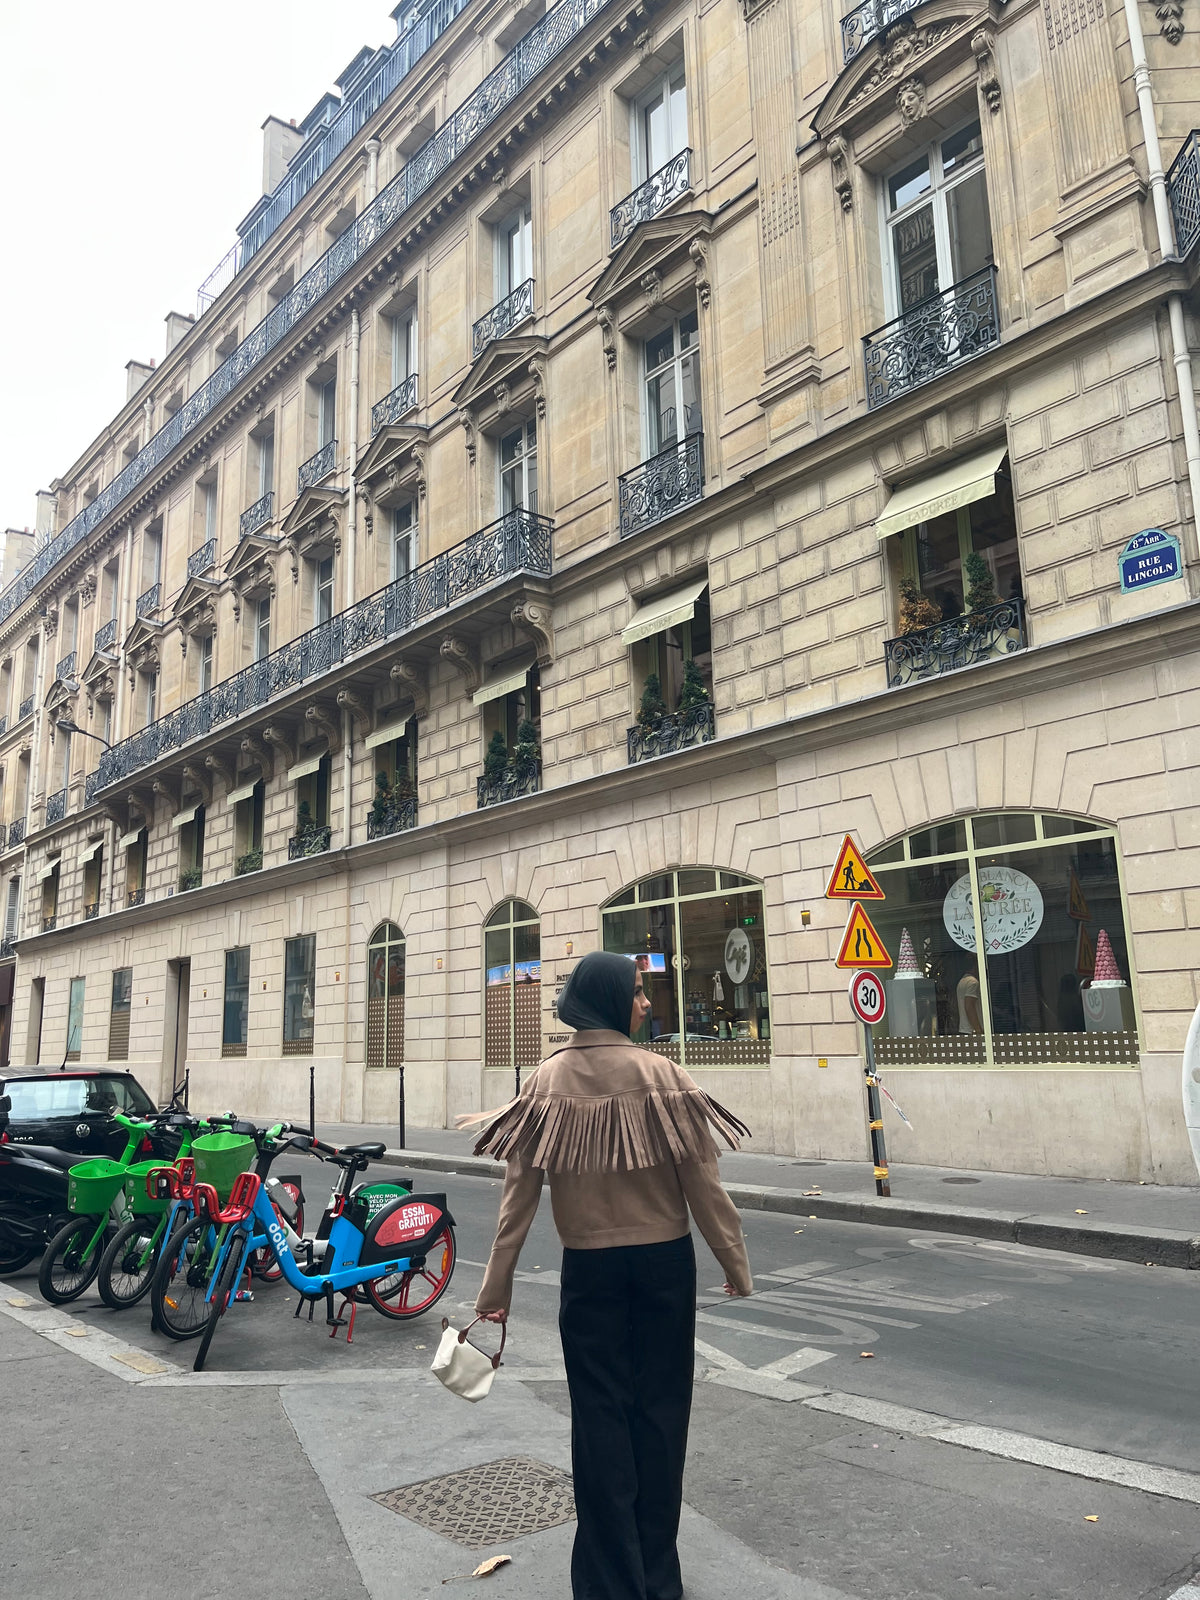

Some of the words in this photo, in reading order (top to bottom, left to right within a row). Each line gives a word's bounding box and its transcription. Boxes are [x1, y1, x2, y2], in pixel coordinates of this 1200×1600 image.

[1128, 562, 1173, 583] LINCOLN
[1138, 555, 1161, 569] RUE
[950, 870, 1030, 900] CASBLANCA
[861, 985, 877, 1009] 30
[402, 1205, 425, 1219] ESSAI
[268, 1222, 289, 1257] dott
